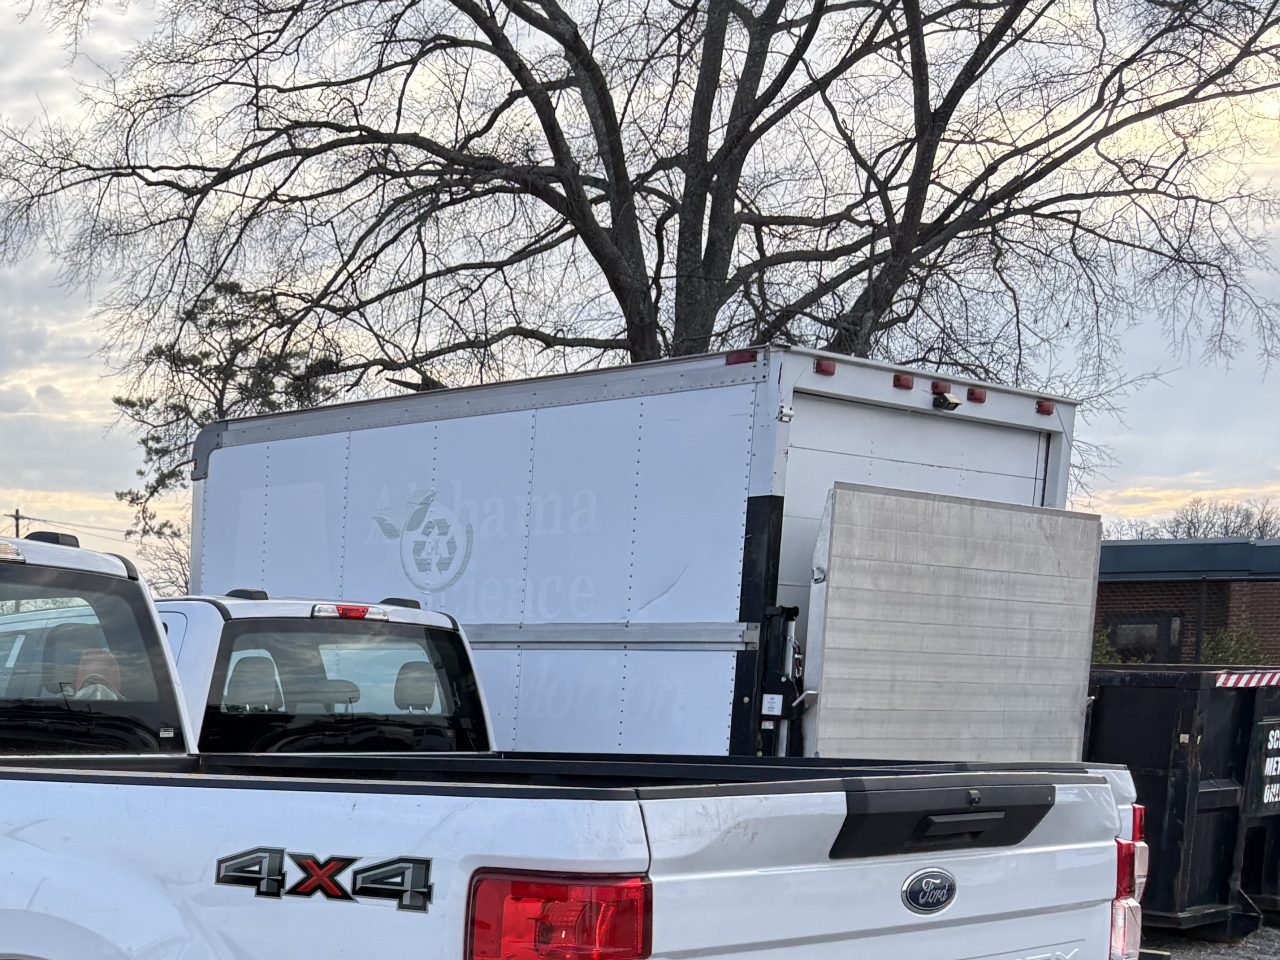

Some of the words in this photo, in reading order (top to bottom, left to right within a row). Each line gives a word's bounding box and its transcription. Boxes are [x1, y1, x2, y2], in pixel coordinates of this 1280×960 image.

[363, 479, 599, 546] Abama
[1267, 729, 1280, 750] SC
[919, 878, 949, 904] Ford
